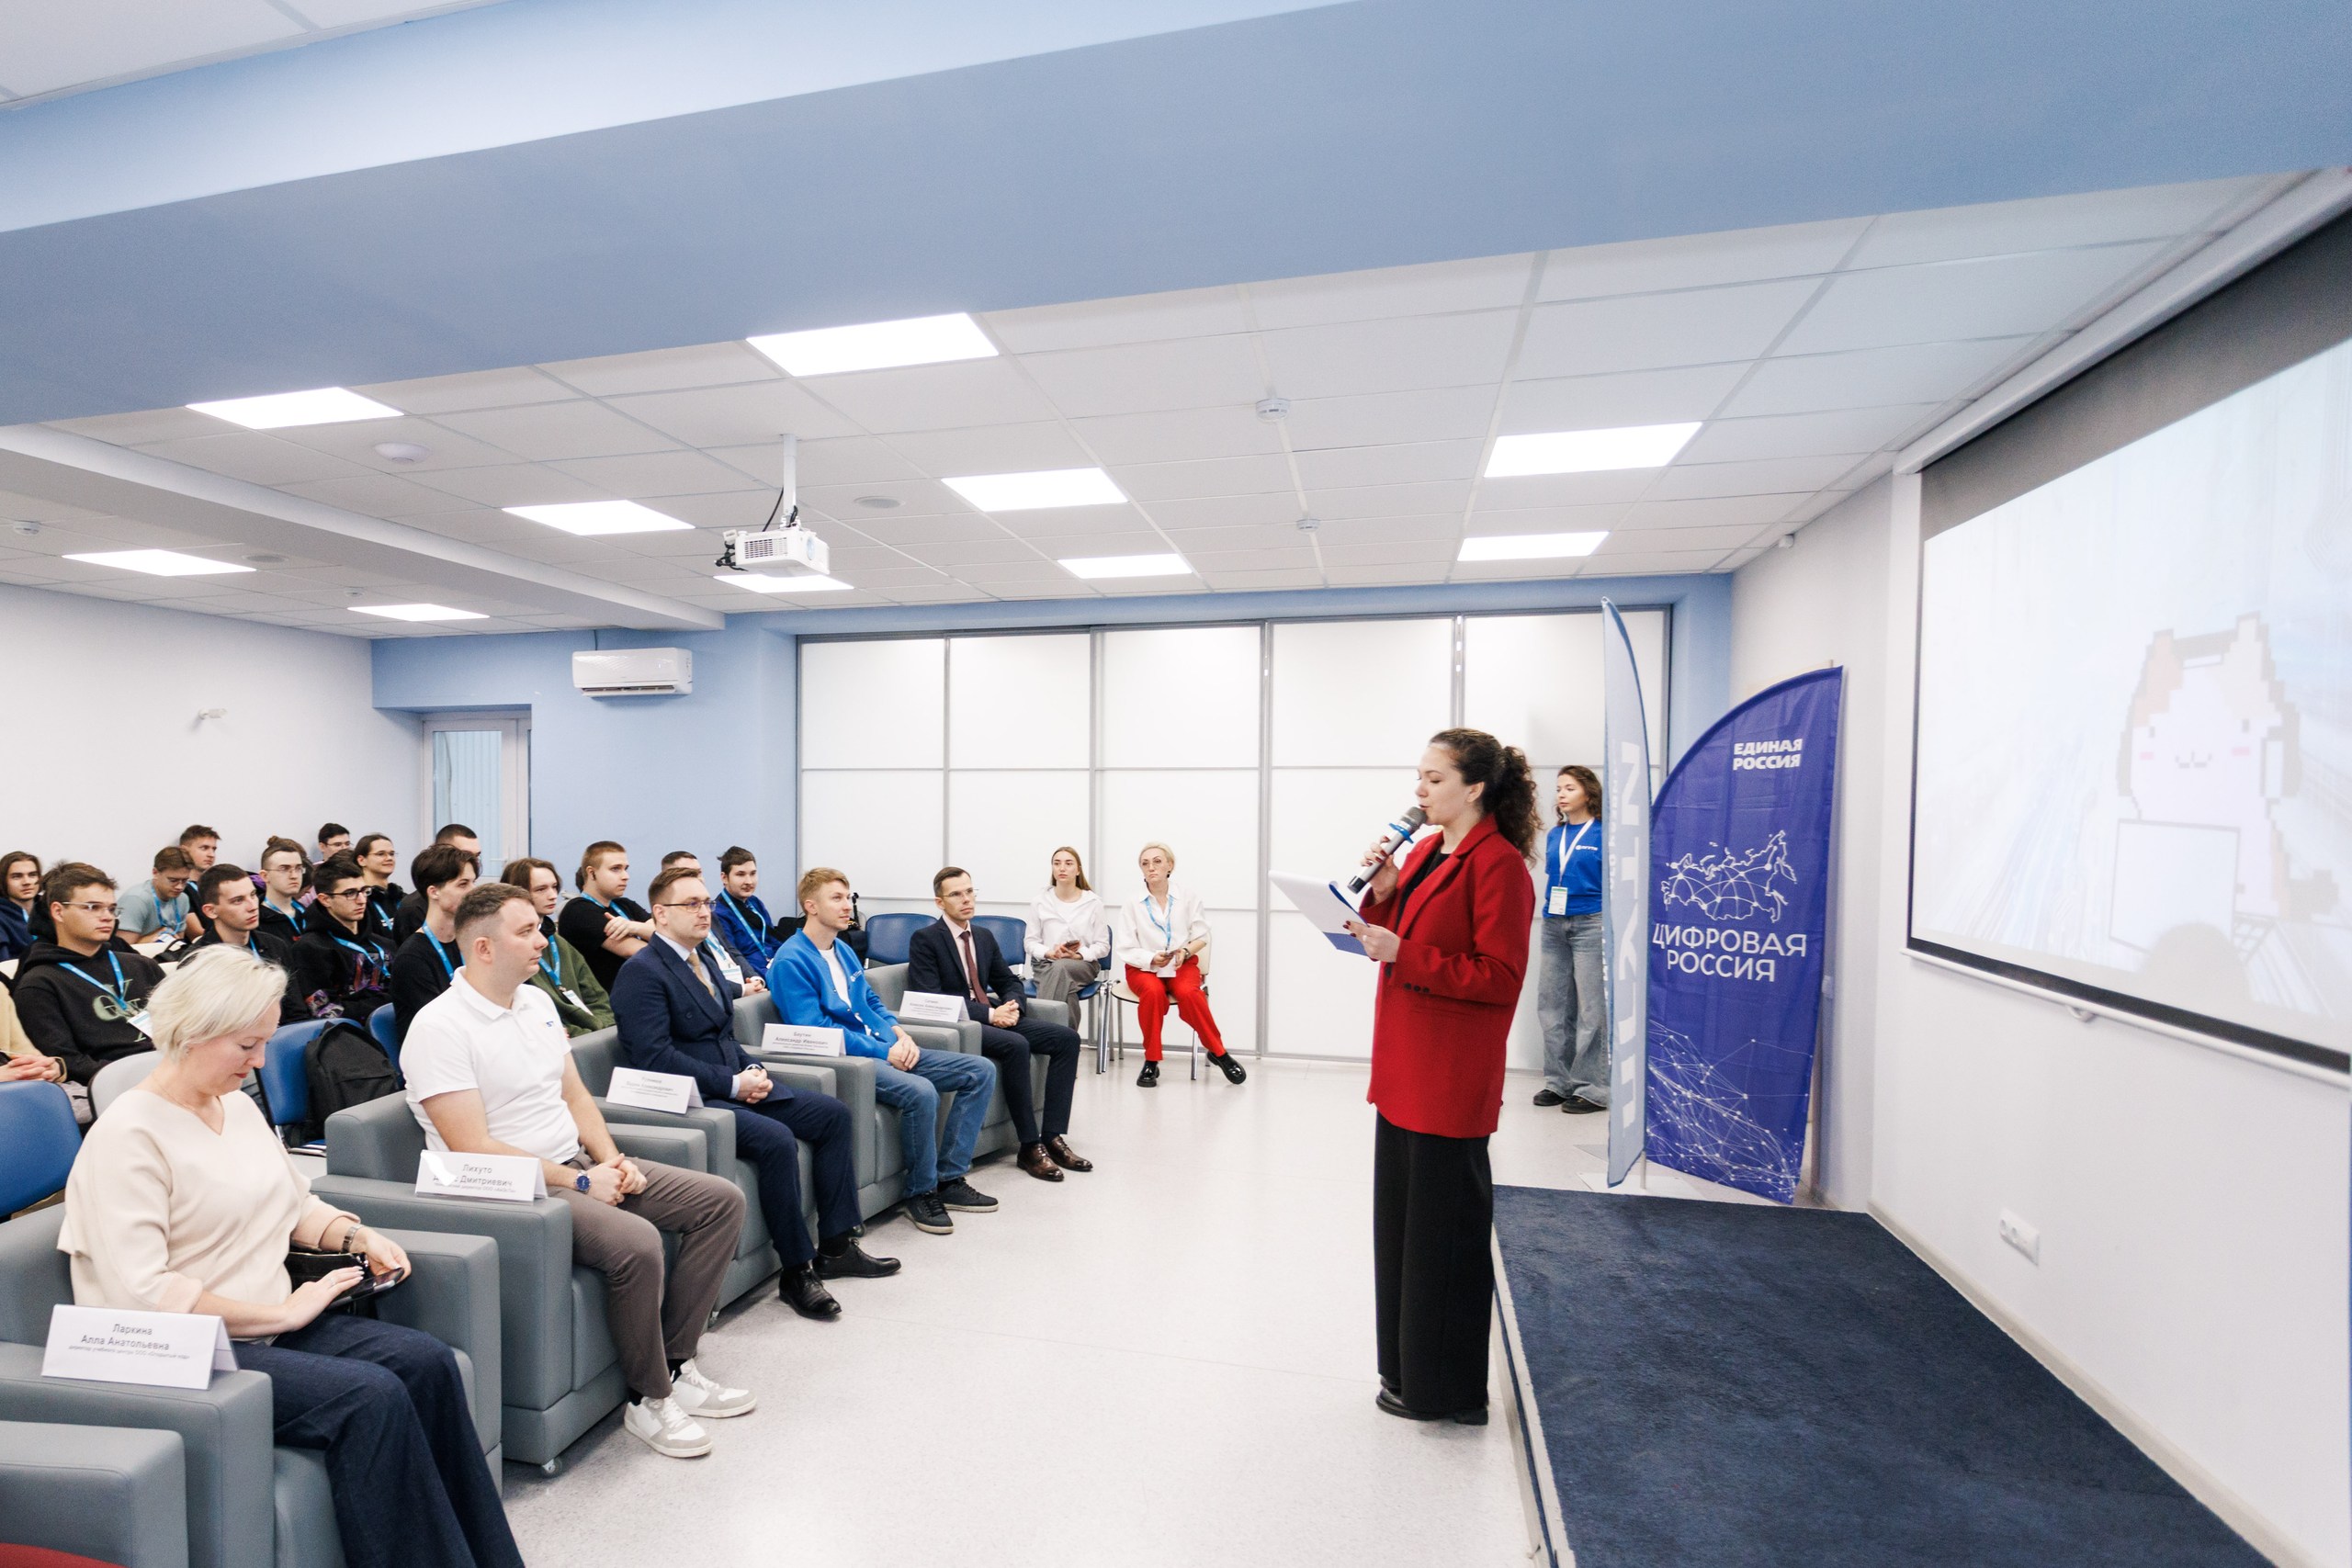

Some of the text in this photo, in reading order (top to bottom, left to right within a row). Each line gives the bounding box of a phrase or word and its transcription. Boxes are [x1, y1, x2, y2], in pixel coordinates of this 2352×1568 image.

[1734, 739, 1803, 755] ЕДИНАЯ
[1733, 754, 1801, 771] РОССИЯ
[1653, 923, 1807, 957] ЦИФРОВАЯ
[1667, 950, 1776, 982] РОССИЯ
[460, 1176, 514, 1187] Дмитриевич
[112, 1323, 153, 1336] Ларкина
[81, 1335, 170, 1351] Алла Анатольевна
